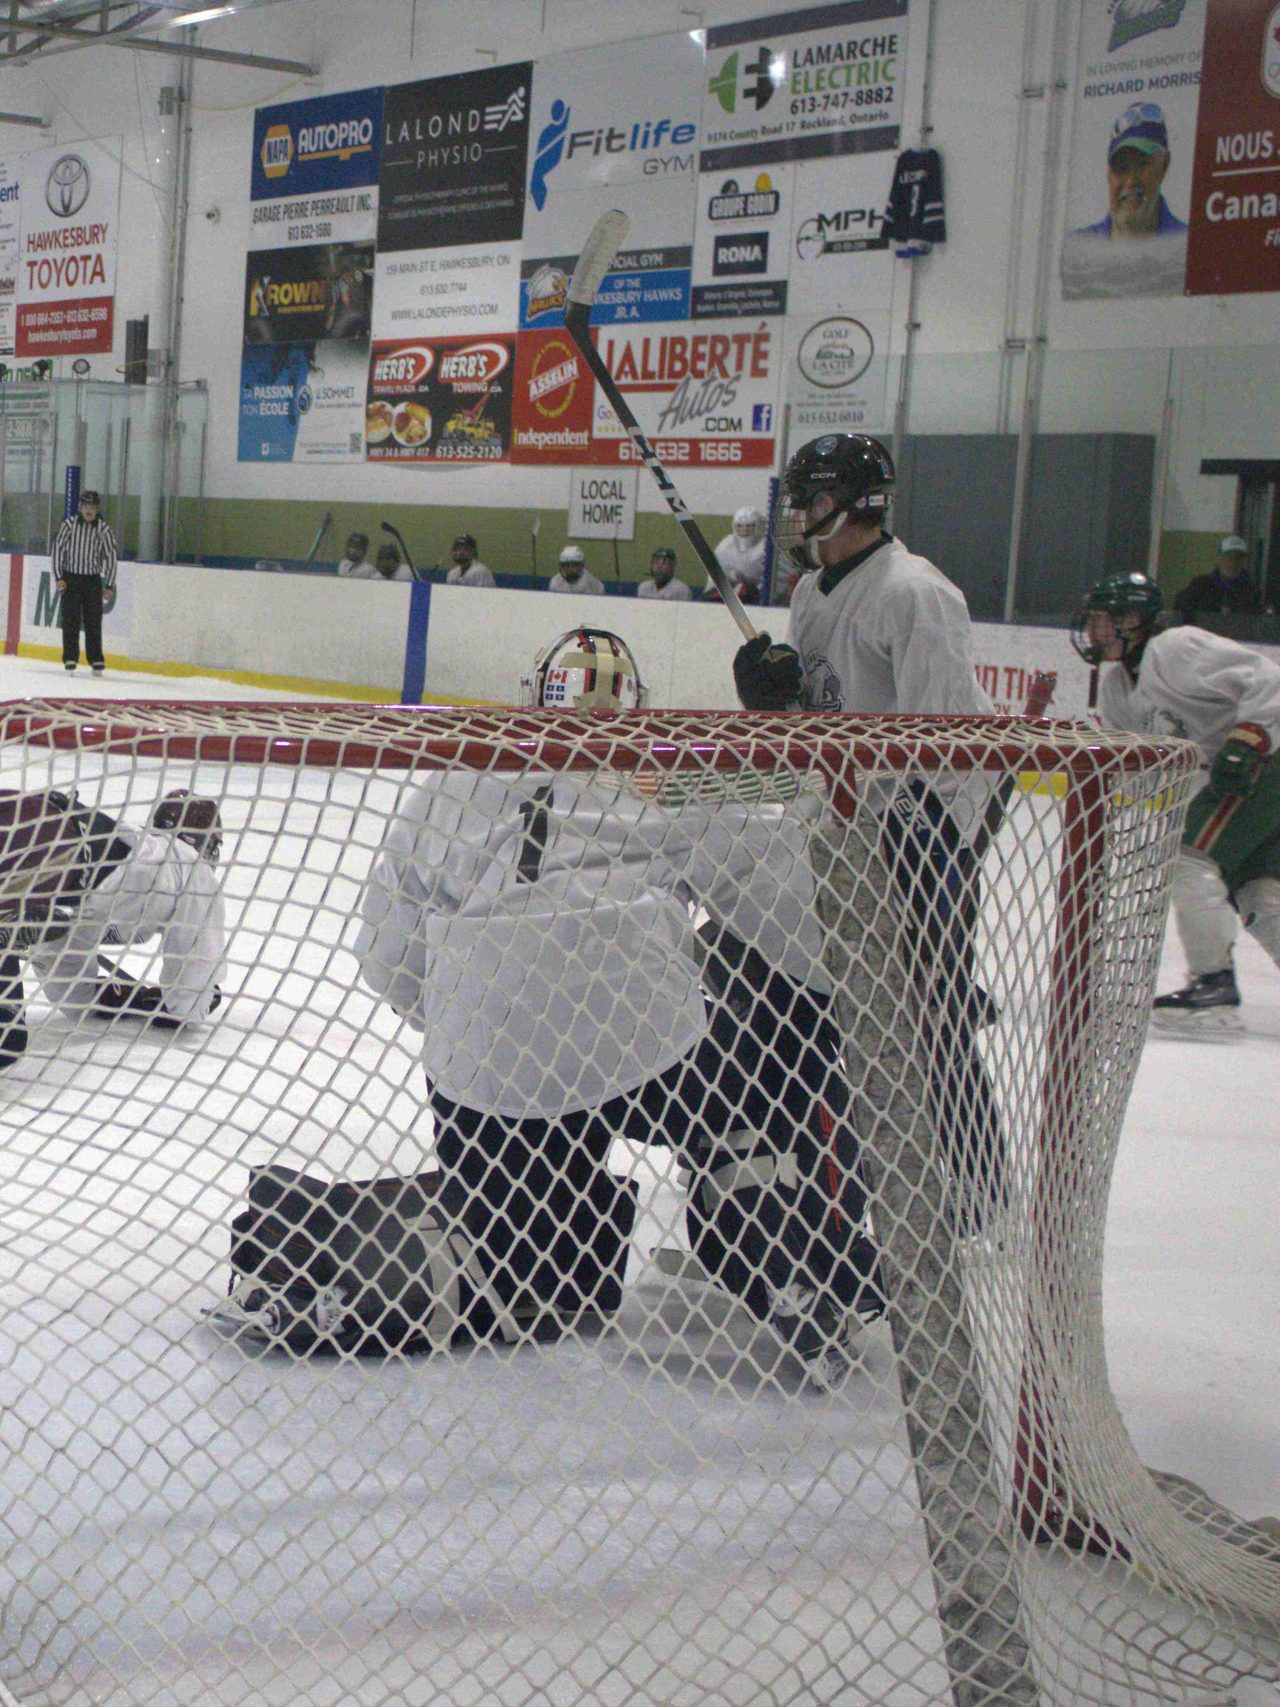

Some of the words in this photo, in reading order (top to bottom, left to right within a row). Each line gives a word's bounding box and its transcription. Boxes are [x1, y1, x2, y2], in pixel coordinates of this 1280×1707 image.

[793, 35, 898, 68] LAMARCHE
[791, 58, 896, 95] ELECTRIC
[1084, 79, 1144, 98] RICHARD
[1148, 71, 1201, 91] MORRIS
[790, 86, 894, 115] 613-747-8882
[760, 122, 783, 136] Road
[849, 110, 889, 124] Ontario
[298, 118, 373, 153] AUTOPRO
[567, 119, 696, 159] Fitlife
[266, 138, 289, 165] NAPA
[417, 143, 482, 169] PHYSIO
[1216, 131, 1273, 163] NOUS
[643, 154, 694, 175] GYM
[253, 203, 282, 224] GARAGE
[283, 201, 309, 220] PIERRE
[310, 195, 355, 217] PERREAULT
[27, 223, 108, 252] HAWKESBURY
[288, 223, 299, 241] 613
[399, 263, 417, 274] MAIN
[419, 261, 429, 272] ST
[497, 255, 510, 265] ON
[640, 252, 663, 266] GYM
[717, 244, 762, 264] RONA
[27, 253, 105, 290] TOYOTA
[626, 278, 641, 288] THE
[644, 288, 683, 302] HAWKS
[28, 328, 97, 343] hawkesburytoyota.com
[822, 328, 850, 339] GOLF
[375, 357, 416, 380] HERB'S
[441, 353, 488, 379] HERB'S
[374, 385, 394, 393] TRAVEL
[395, 384, 416, 392] PLAZA
[453, 382, 488, 393] TOWING
[529, 358, 579, 399] ASSELIN
[254, 386, 294, 399] PASSION
[323, 386, 355, 399] SOMMET
[260, 400, 290, 415] ÉCOLE
[658, 374, 741, 433] Autos
[436, 446, 502, 458] 613-525-2120
[700, 442, 742, 460] 1666
[581, 480, 626, 500] LOCAL
[583, 504, 623, 524] HOME
